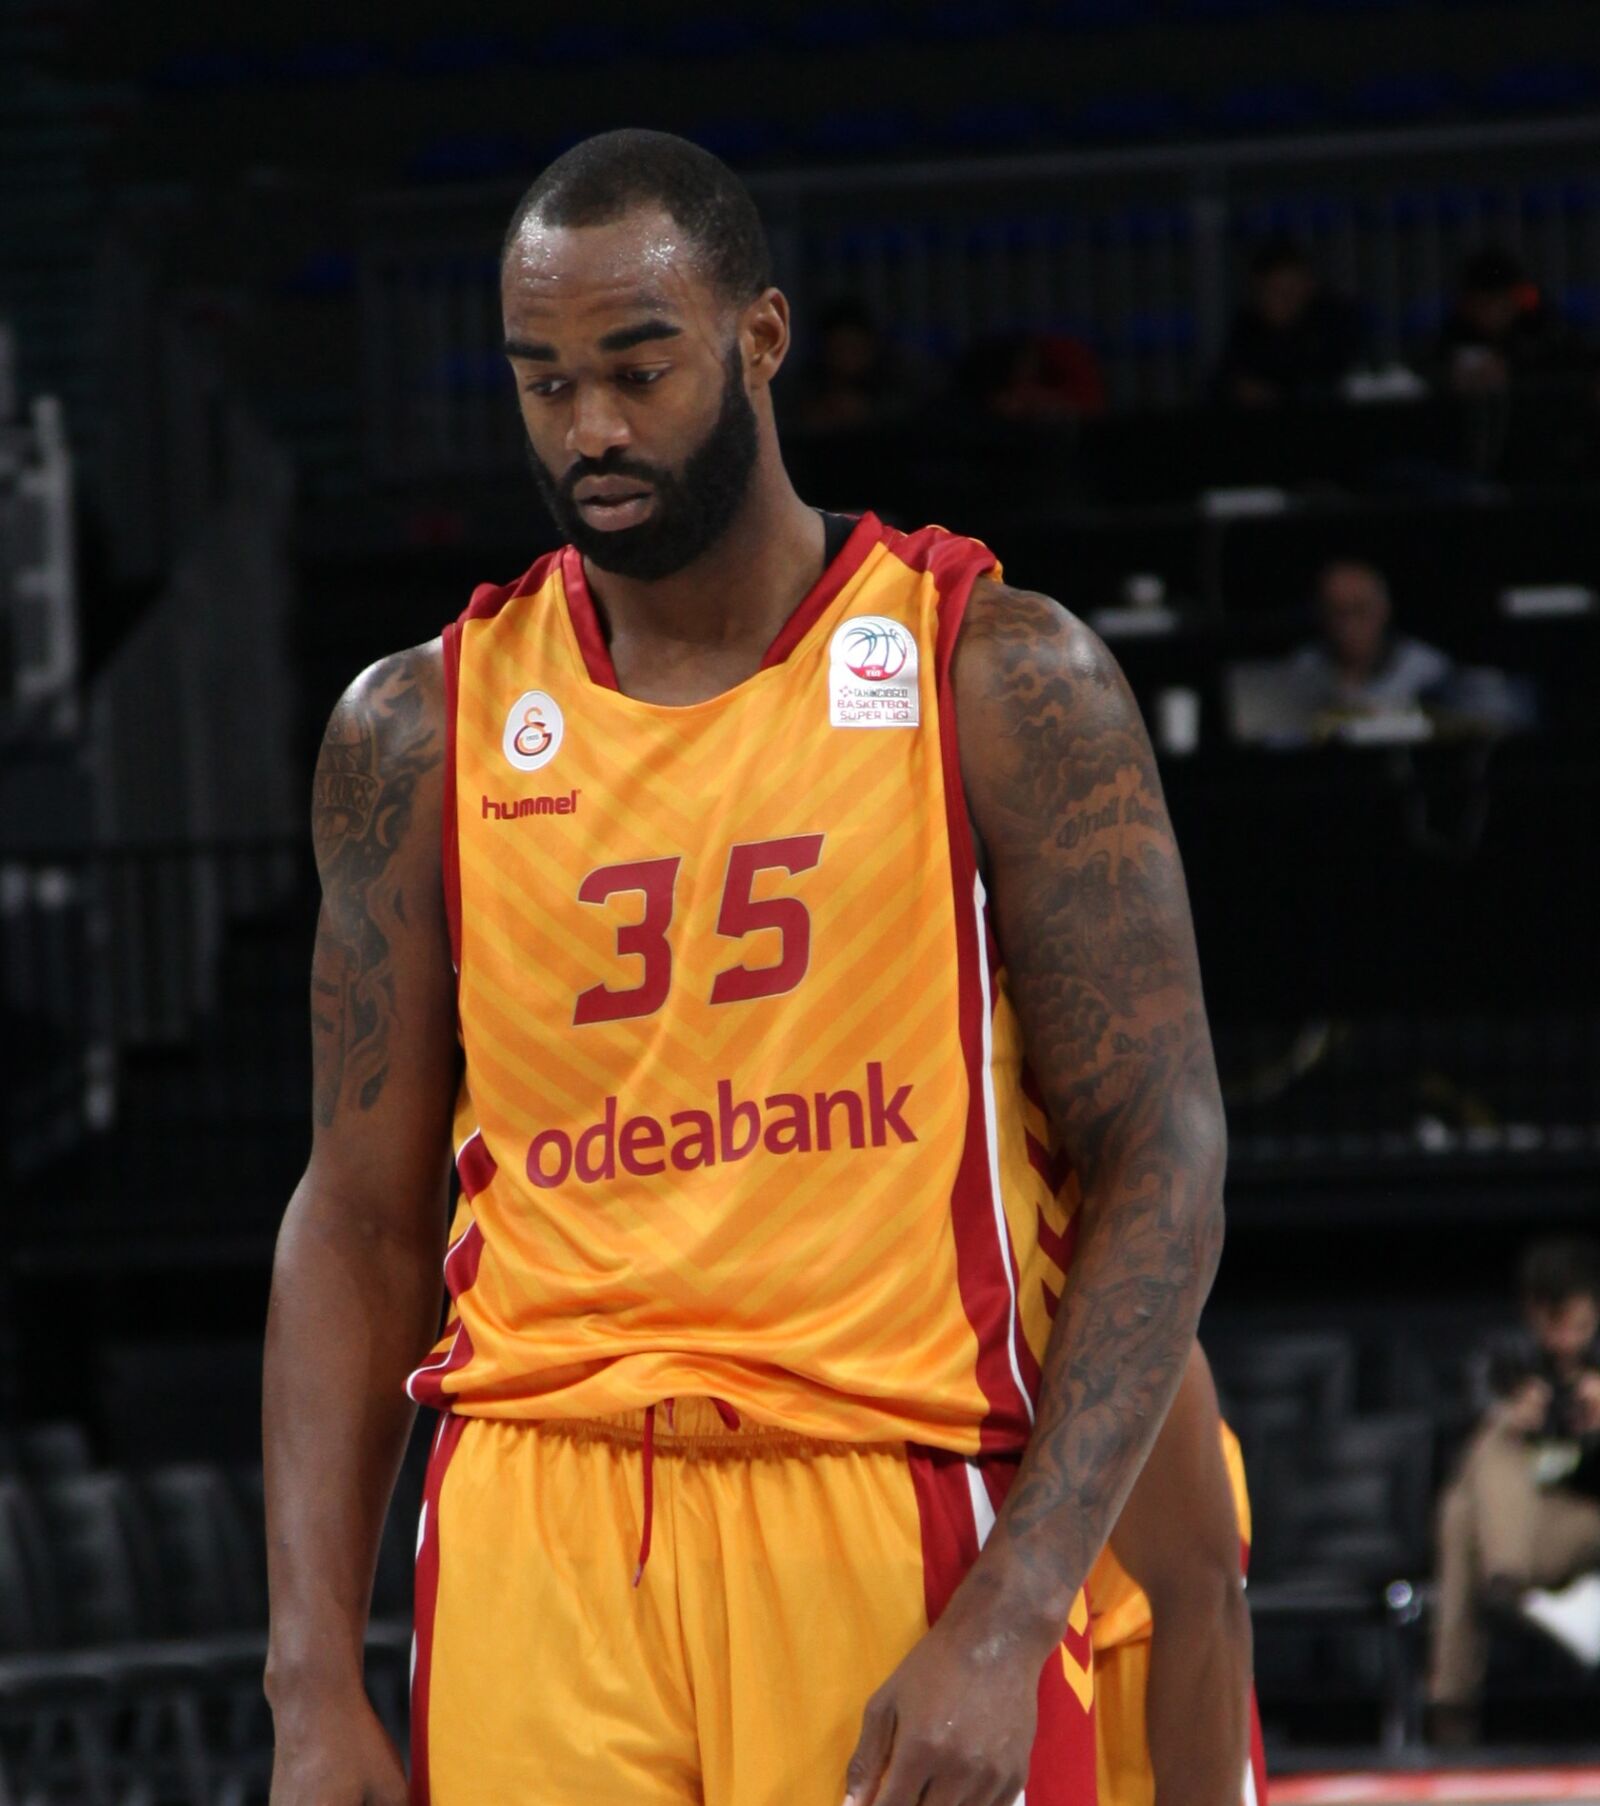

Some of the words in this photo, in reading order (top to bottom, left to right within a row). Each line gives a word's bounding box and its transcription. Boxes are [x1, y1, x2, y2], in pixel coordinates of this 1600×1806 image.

[482, 790, 578, 820] hummel
[572, 832, 826, 1027] 35
[525, 1061, 918, 1190] odeabank
